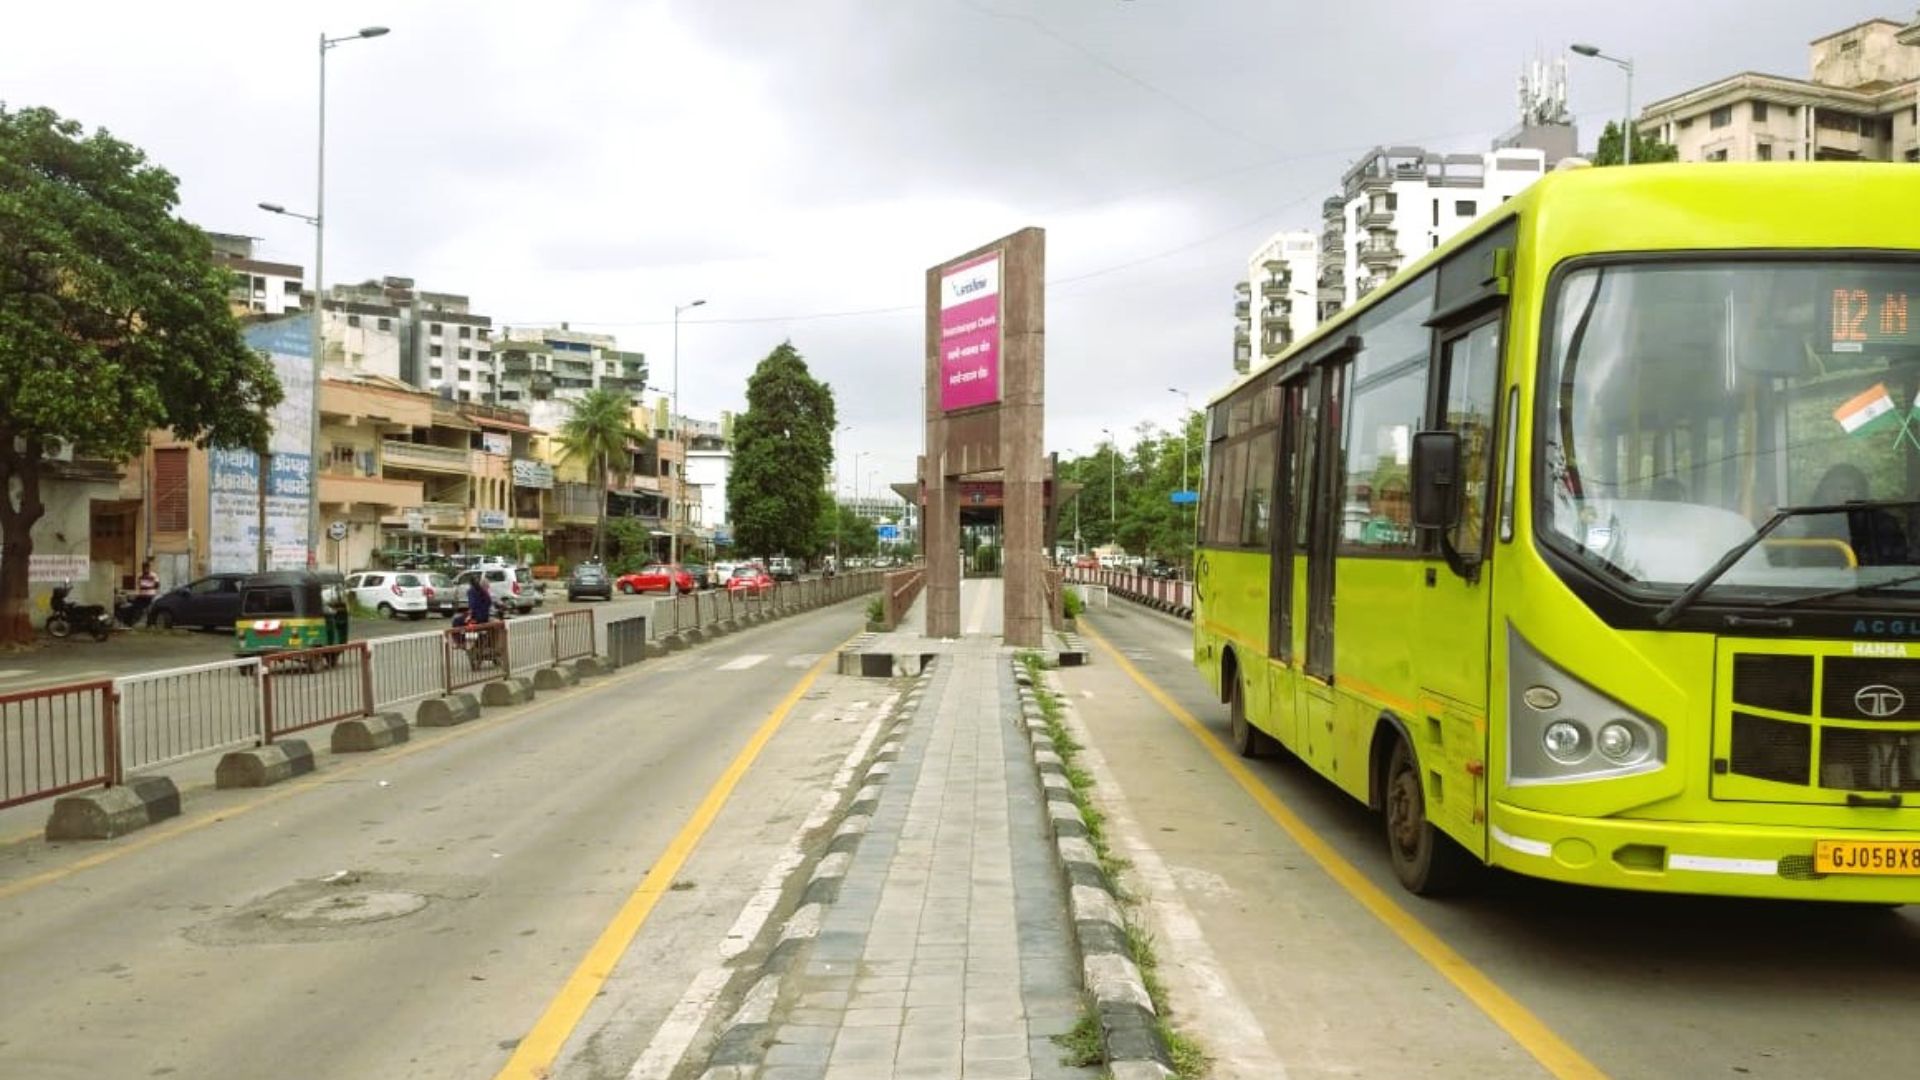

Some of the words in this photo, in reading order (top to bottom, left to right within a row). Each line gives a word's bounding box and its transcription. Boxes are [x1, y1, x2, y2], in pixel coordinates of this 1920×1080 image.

[1854, 619, 1920, 634] ACGL
[1853, 642, 1907, 657] HANSA
[1833, 847, 1920, 868] GJ05BX8
